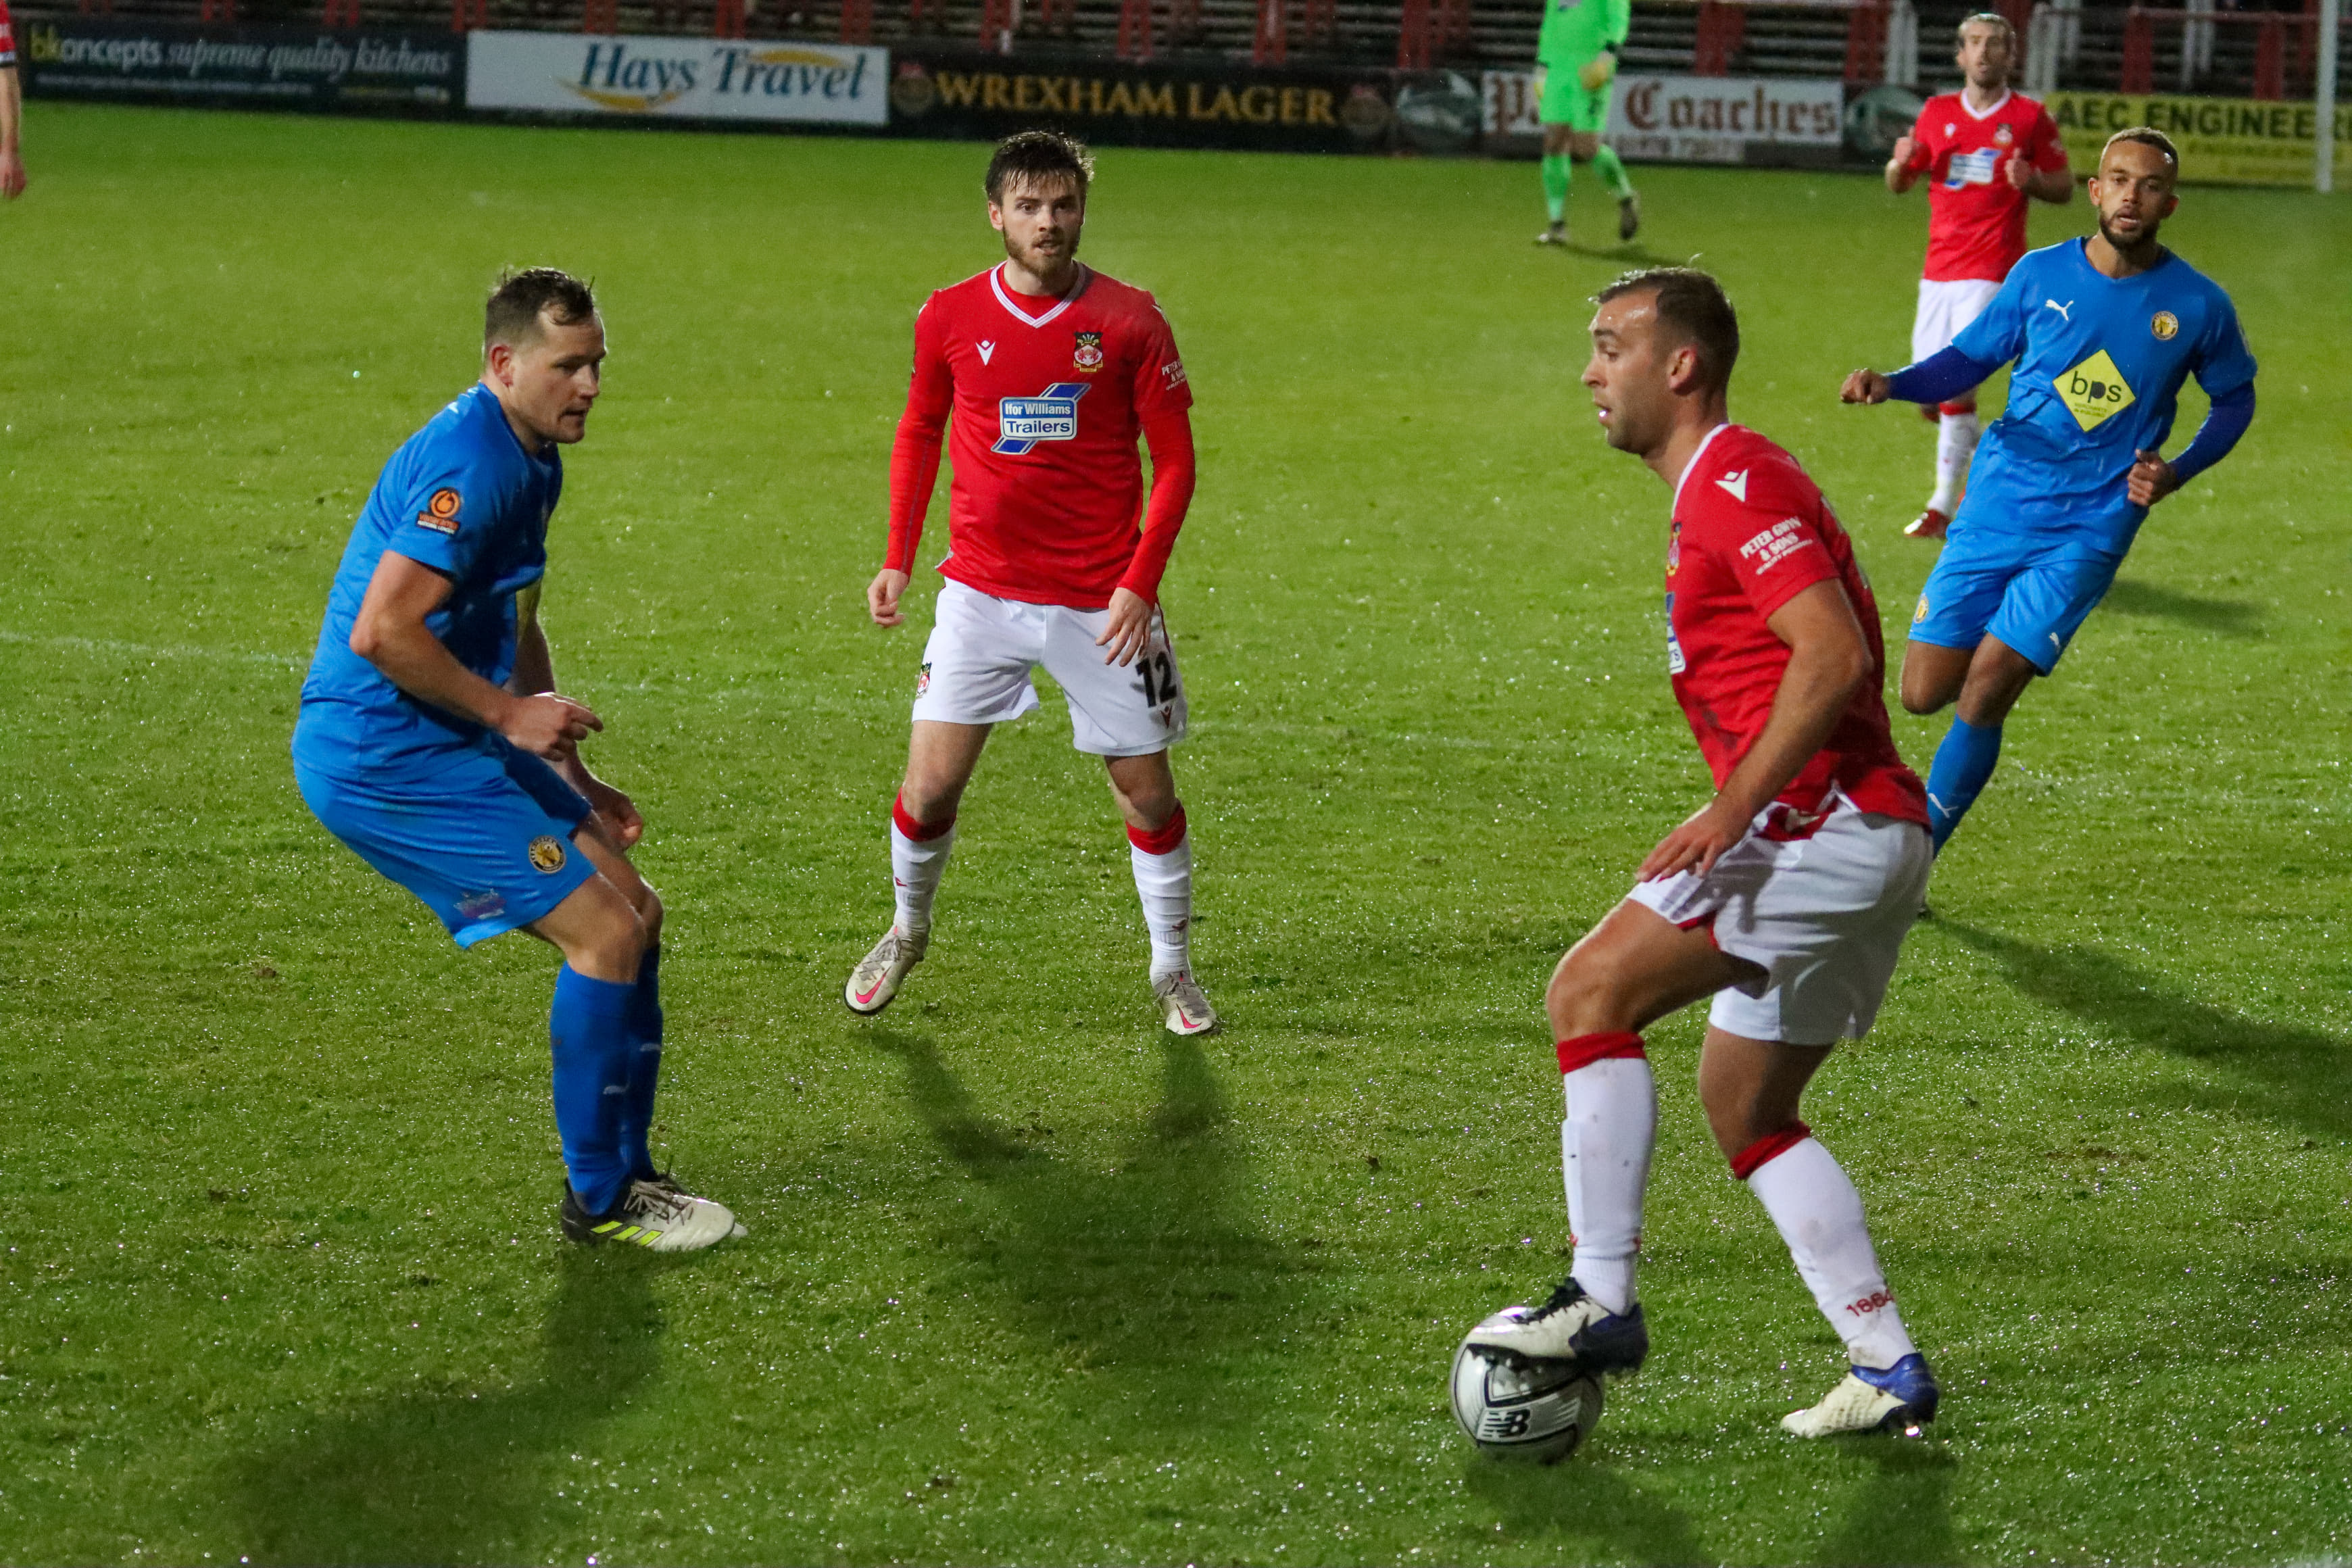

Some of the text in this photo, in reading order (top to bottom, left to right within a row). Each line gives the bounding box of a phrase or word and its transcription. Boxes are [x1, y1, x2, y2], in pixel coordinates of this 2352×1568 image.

[353, 37, 451, 74] kitchens
[578, 42, 867, 107] Hays Travel
[935, 72, 1338, 126] WREXHAM LAGER
[1625, 81, 1837, 134] Coaches
[2056, 99, 2352, 140] AEC ENGINEE
[2071, 370, 2122, 403] bps
[1005, 403, 1071, 415] Ifor Williams
[1006, 420, 1070, 433] Trailers
[1740, 530, 1775, 559] PETER
[1135, 651, 1177, 708] 12
